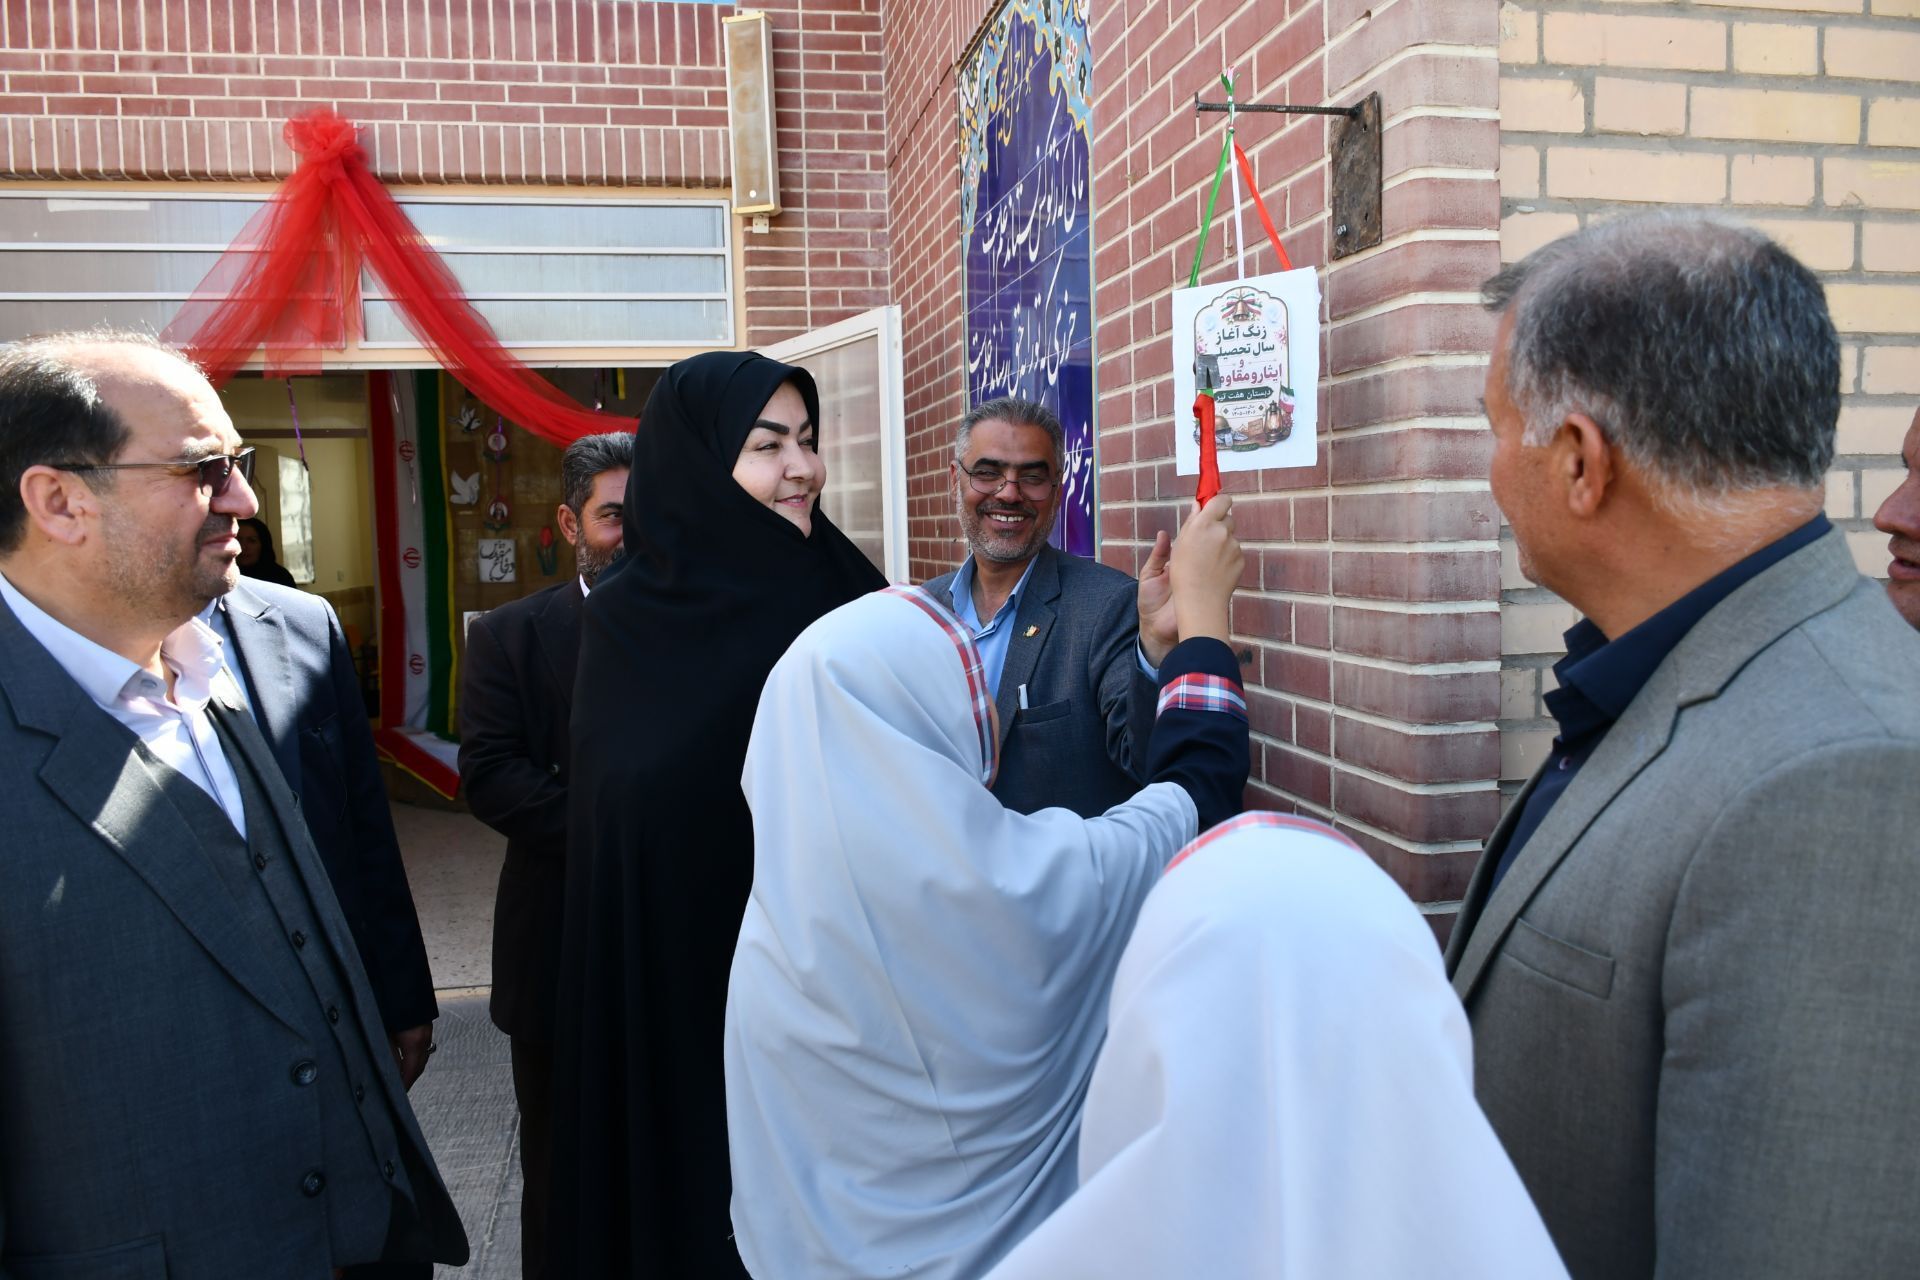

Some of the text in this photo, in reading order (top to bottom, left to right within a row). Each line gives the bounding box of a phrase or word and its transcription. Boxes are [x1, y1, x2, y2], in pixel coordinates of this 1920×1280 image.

[1216, 323, 1267, 345] زنگ آغاز
[1217, 341, 1275, 360] سال تحصیل
[1239, 359, 1245, 368] و
[1219, 369, 1250, 387] مقاوم
[1256, 363, 1282, 383] ایثار
[1228, 390, 1245, 399] هفت
[1246, 388, 1271, 400] دبستان
